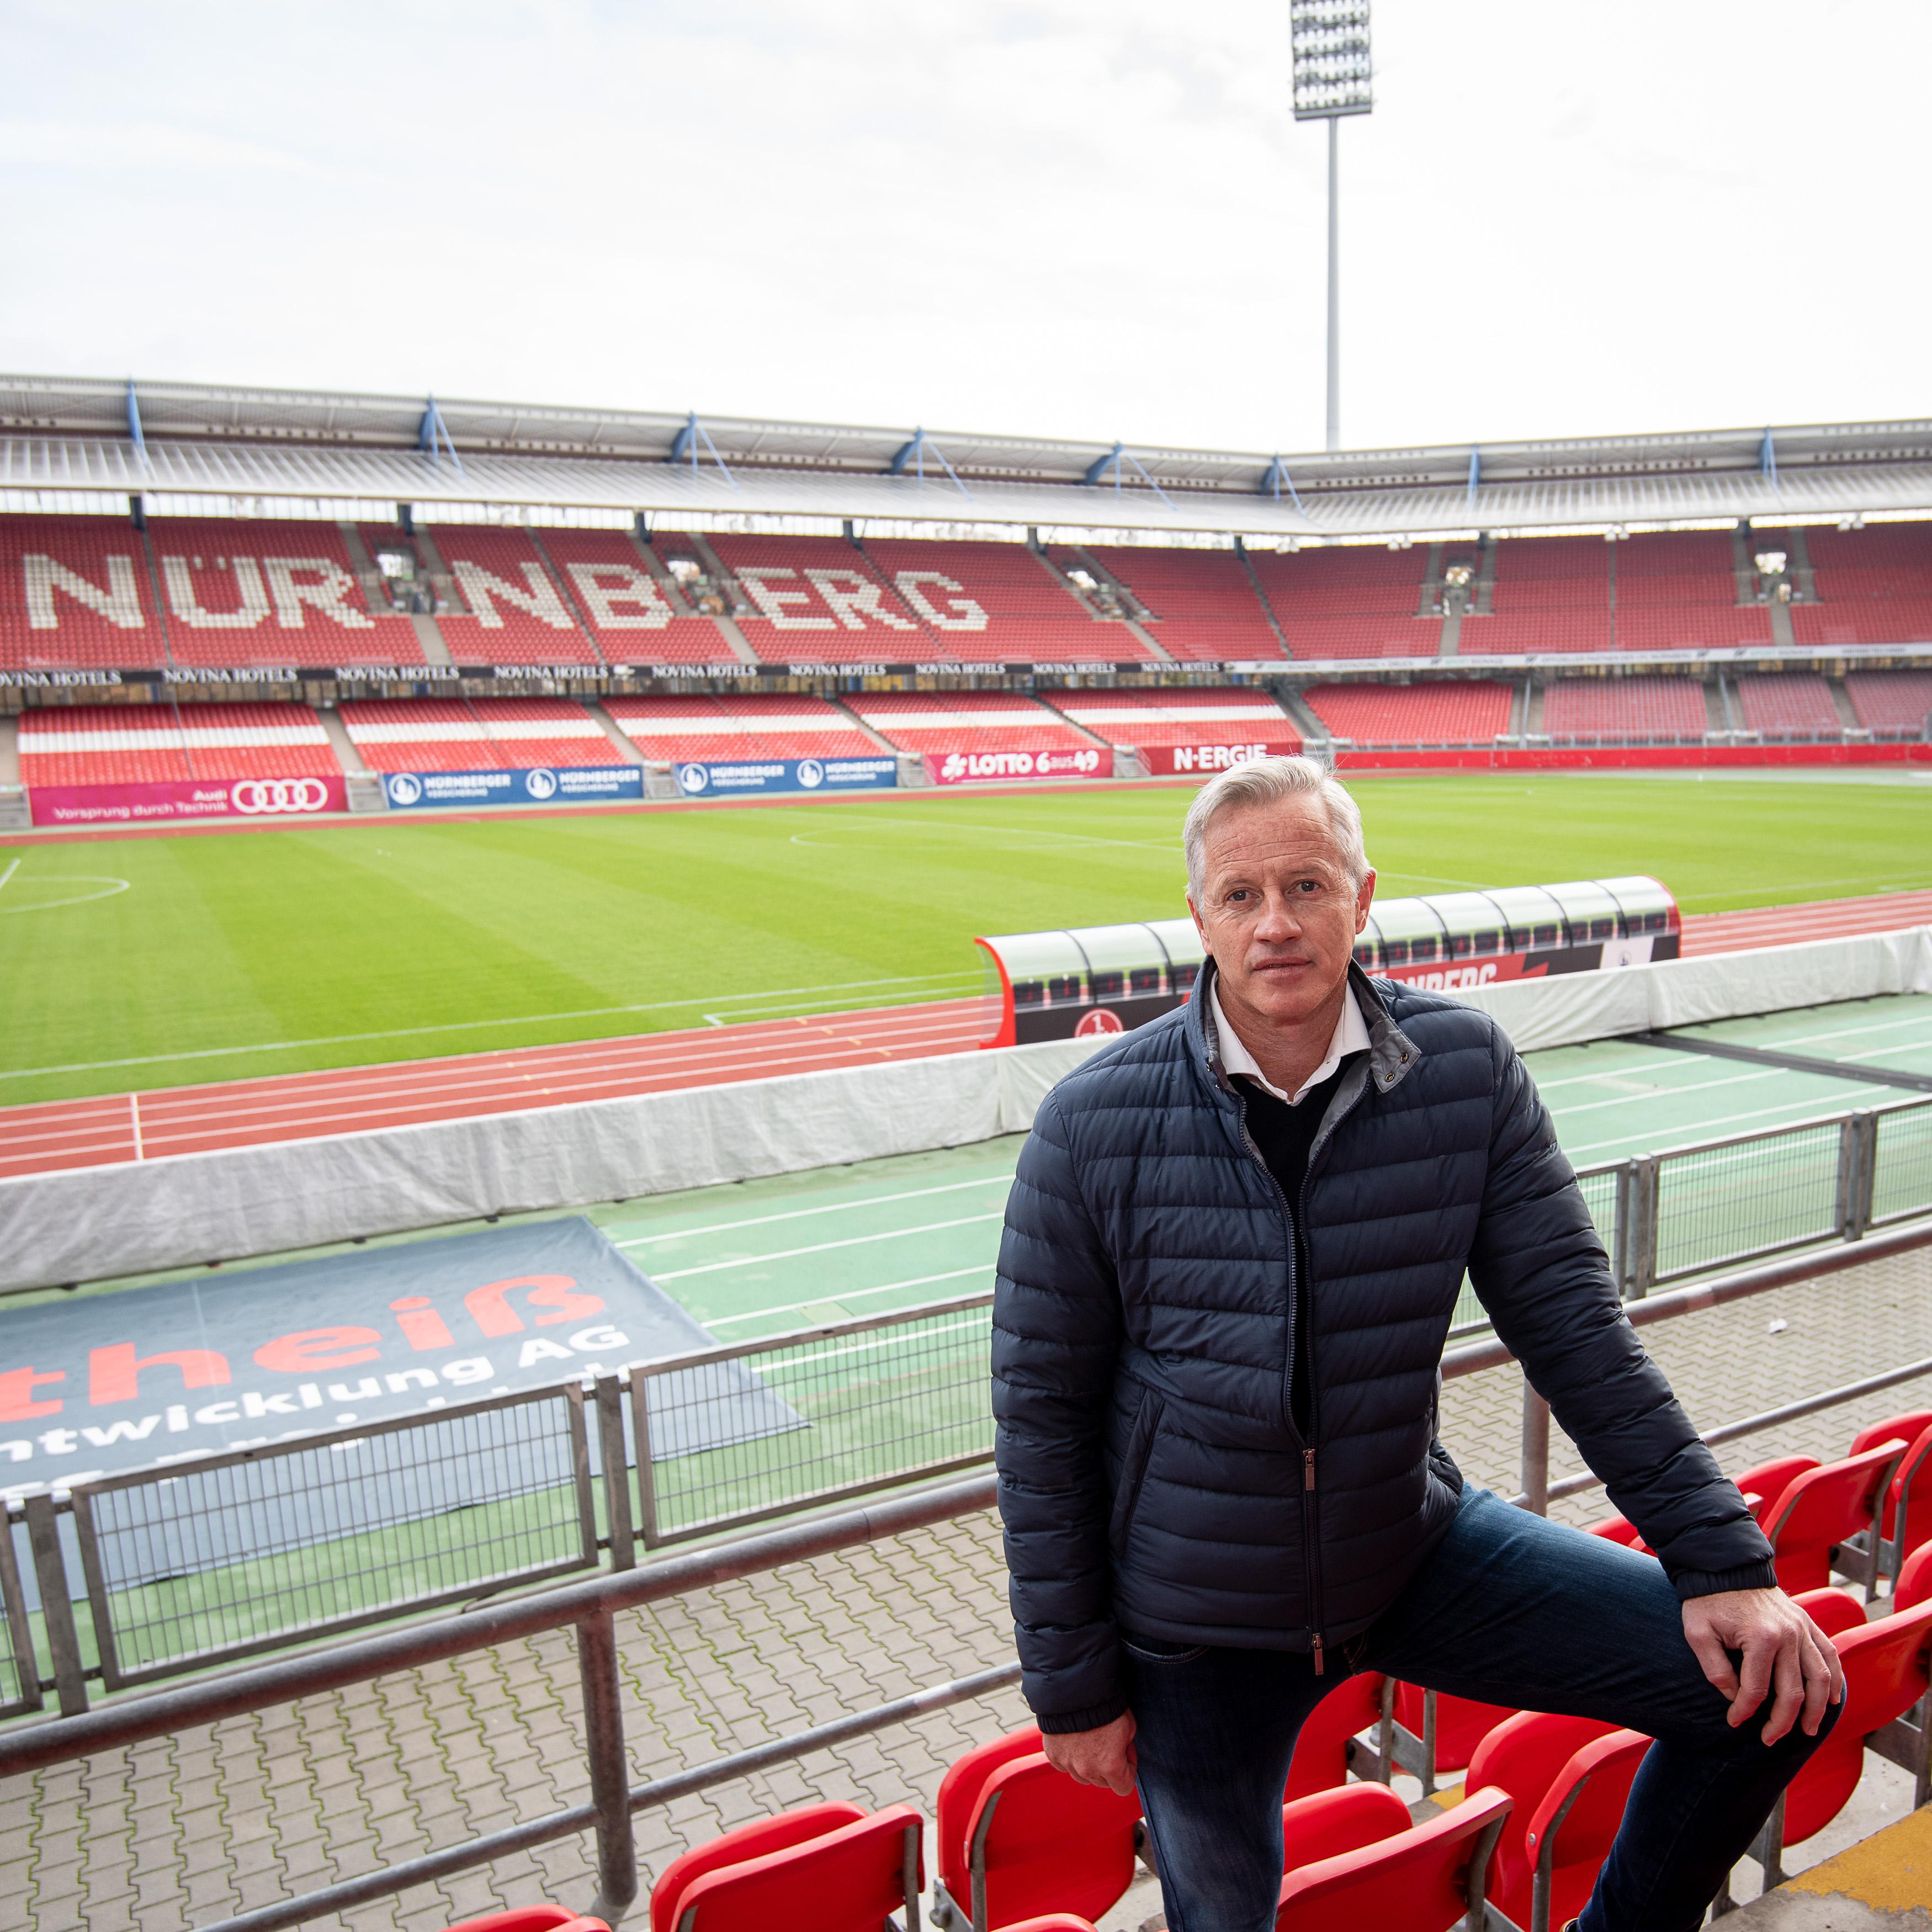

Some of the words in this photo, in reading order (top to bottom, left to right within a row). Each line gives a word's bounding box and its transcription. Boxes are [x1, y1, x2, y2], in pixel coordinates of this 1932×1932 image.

[23, 554, 990, 630] NÜRNBERG
[164, 668, 231, 683] NOVINA
[234, 667, 298, 682] HOTELS
[335, 666, 399, 681] NOVINA
[401, 666, 459, 680] HOTELS
[495, 666, 553, 680] NOVINA
[554, 665, 609, 678] HOTELS
[652, 665, 705, 678] NOVINA
[707, 665, 757, 677] HOTELS
[789, 665, 838, 676] NOVINA
[840, 665, 886, 675] HOTELS
[916, 664, 962, 675] NOVINA
[963, 664, 1005, 674] HOTELS
[53, 669, 123, 686] HOTELS
[826, 761, 895, 774] NÜRNBERGER
[968, 752, 1034, 776] LOTTO
[559, 769, 640, 784] NÜRNBERGER
[710, 765, 785, 779] NÜRNBERGER
[424, 774, 511, 789] NÜRNBERGER
[193, 789, 227, 802] Audi
[53, 805, 130, 820] Vorsprung
[134, 803, 173, 816] durch
[176, 801, 228, 814] Technik
[518, 1325, 630, 1368] AG
